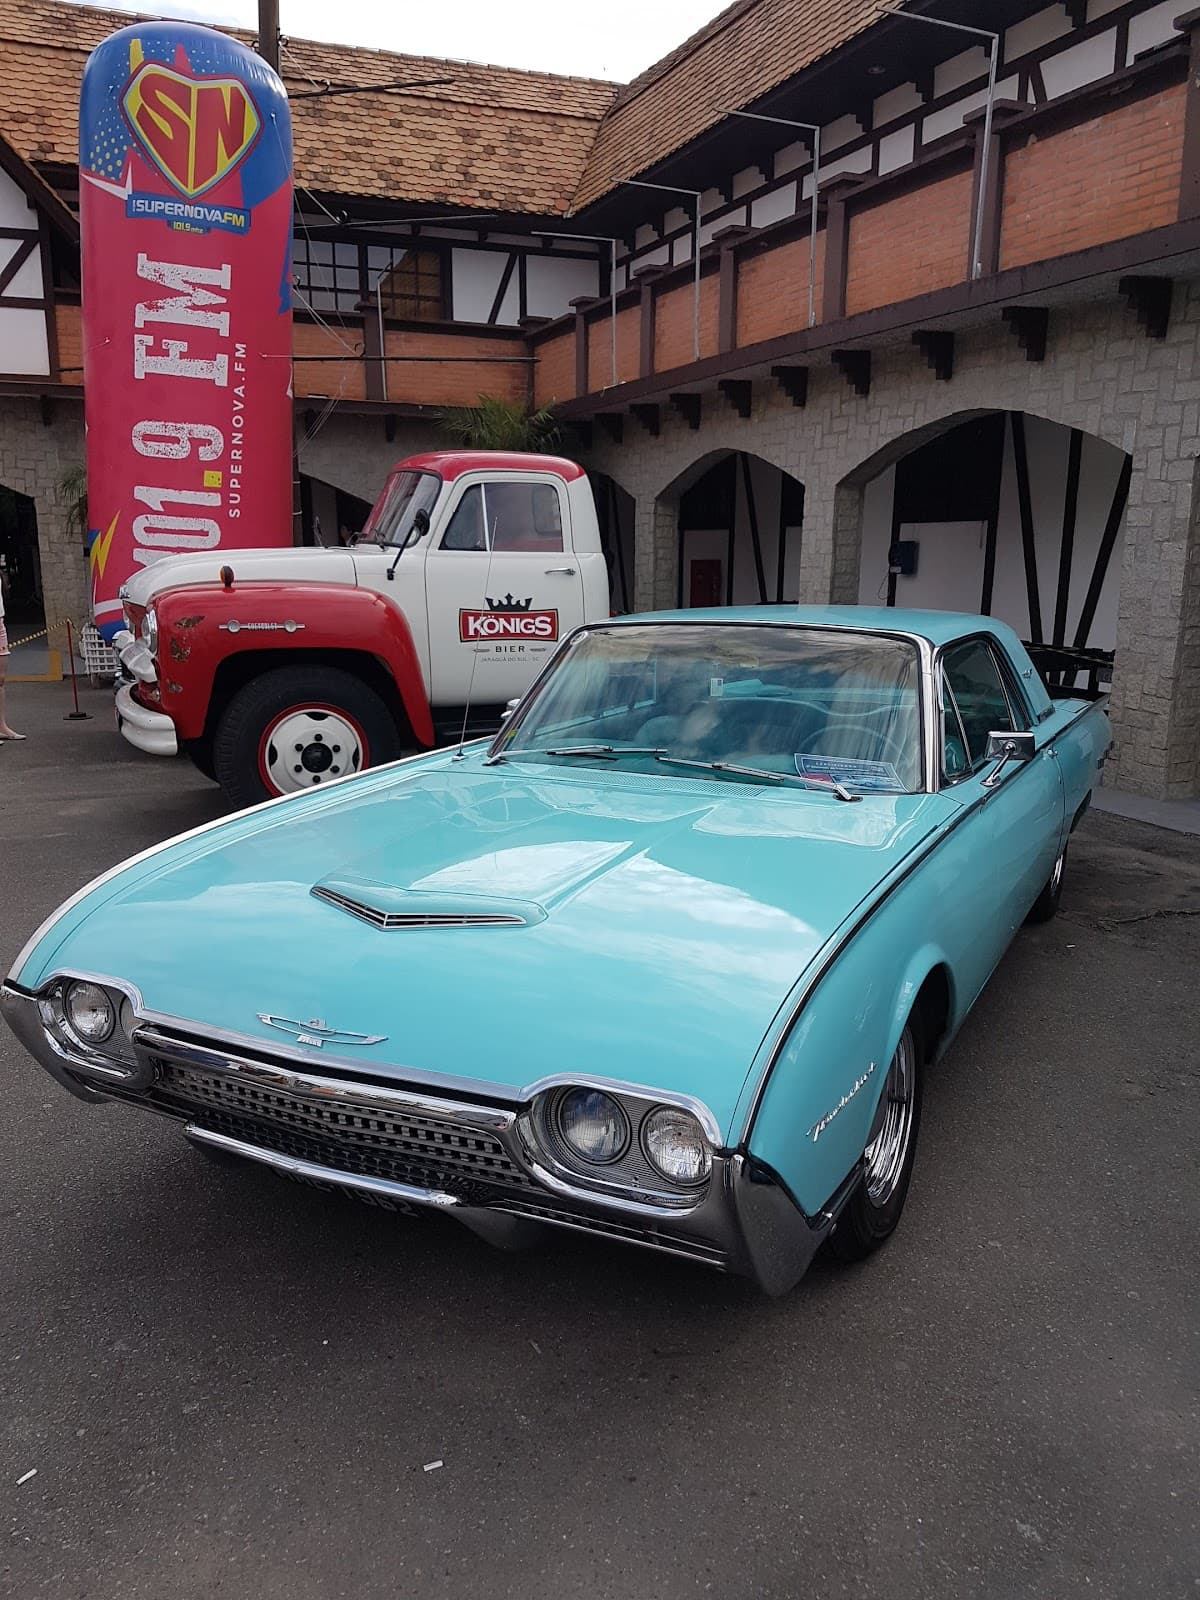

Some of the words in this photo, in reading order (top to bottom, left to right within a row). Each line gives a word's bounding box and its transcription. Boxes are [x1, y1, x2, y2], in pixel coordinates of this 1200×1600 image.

[136, 73, 247, 190] SN
[133, 199, 245, 228] SUPERNOVA.FM
[173, 221, 191, 232] 101.9
[134, 253, 232, 387] FM
[229, 343, 247, 518] SUPERNOVA.FM
[467, 615, 553, 636] KÖNIGS
[495, 645, 526, 653] BIER
